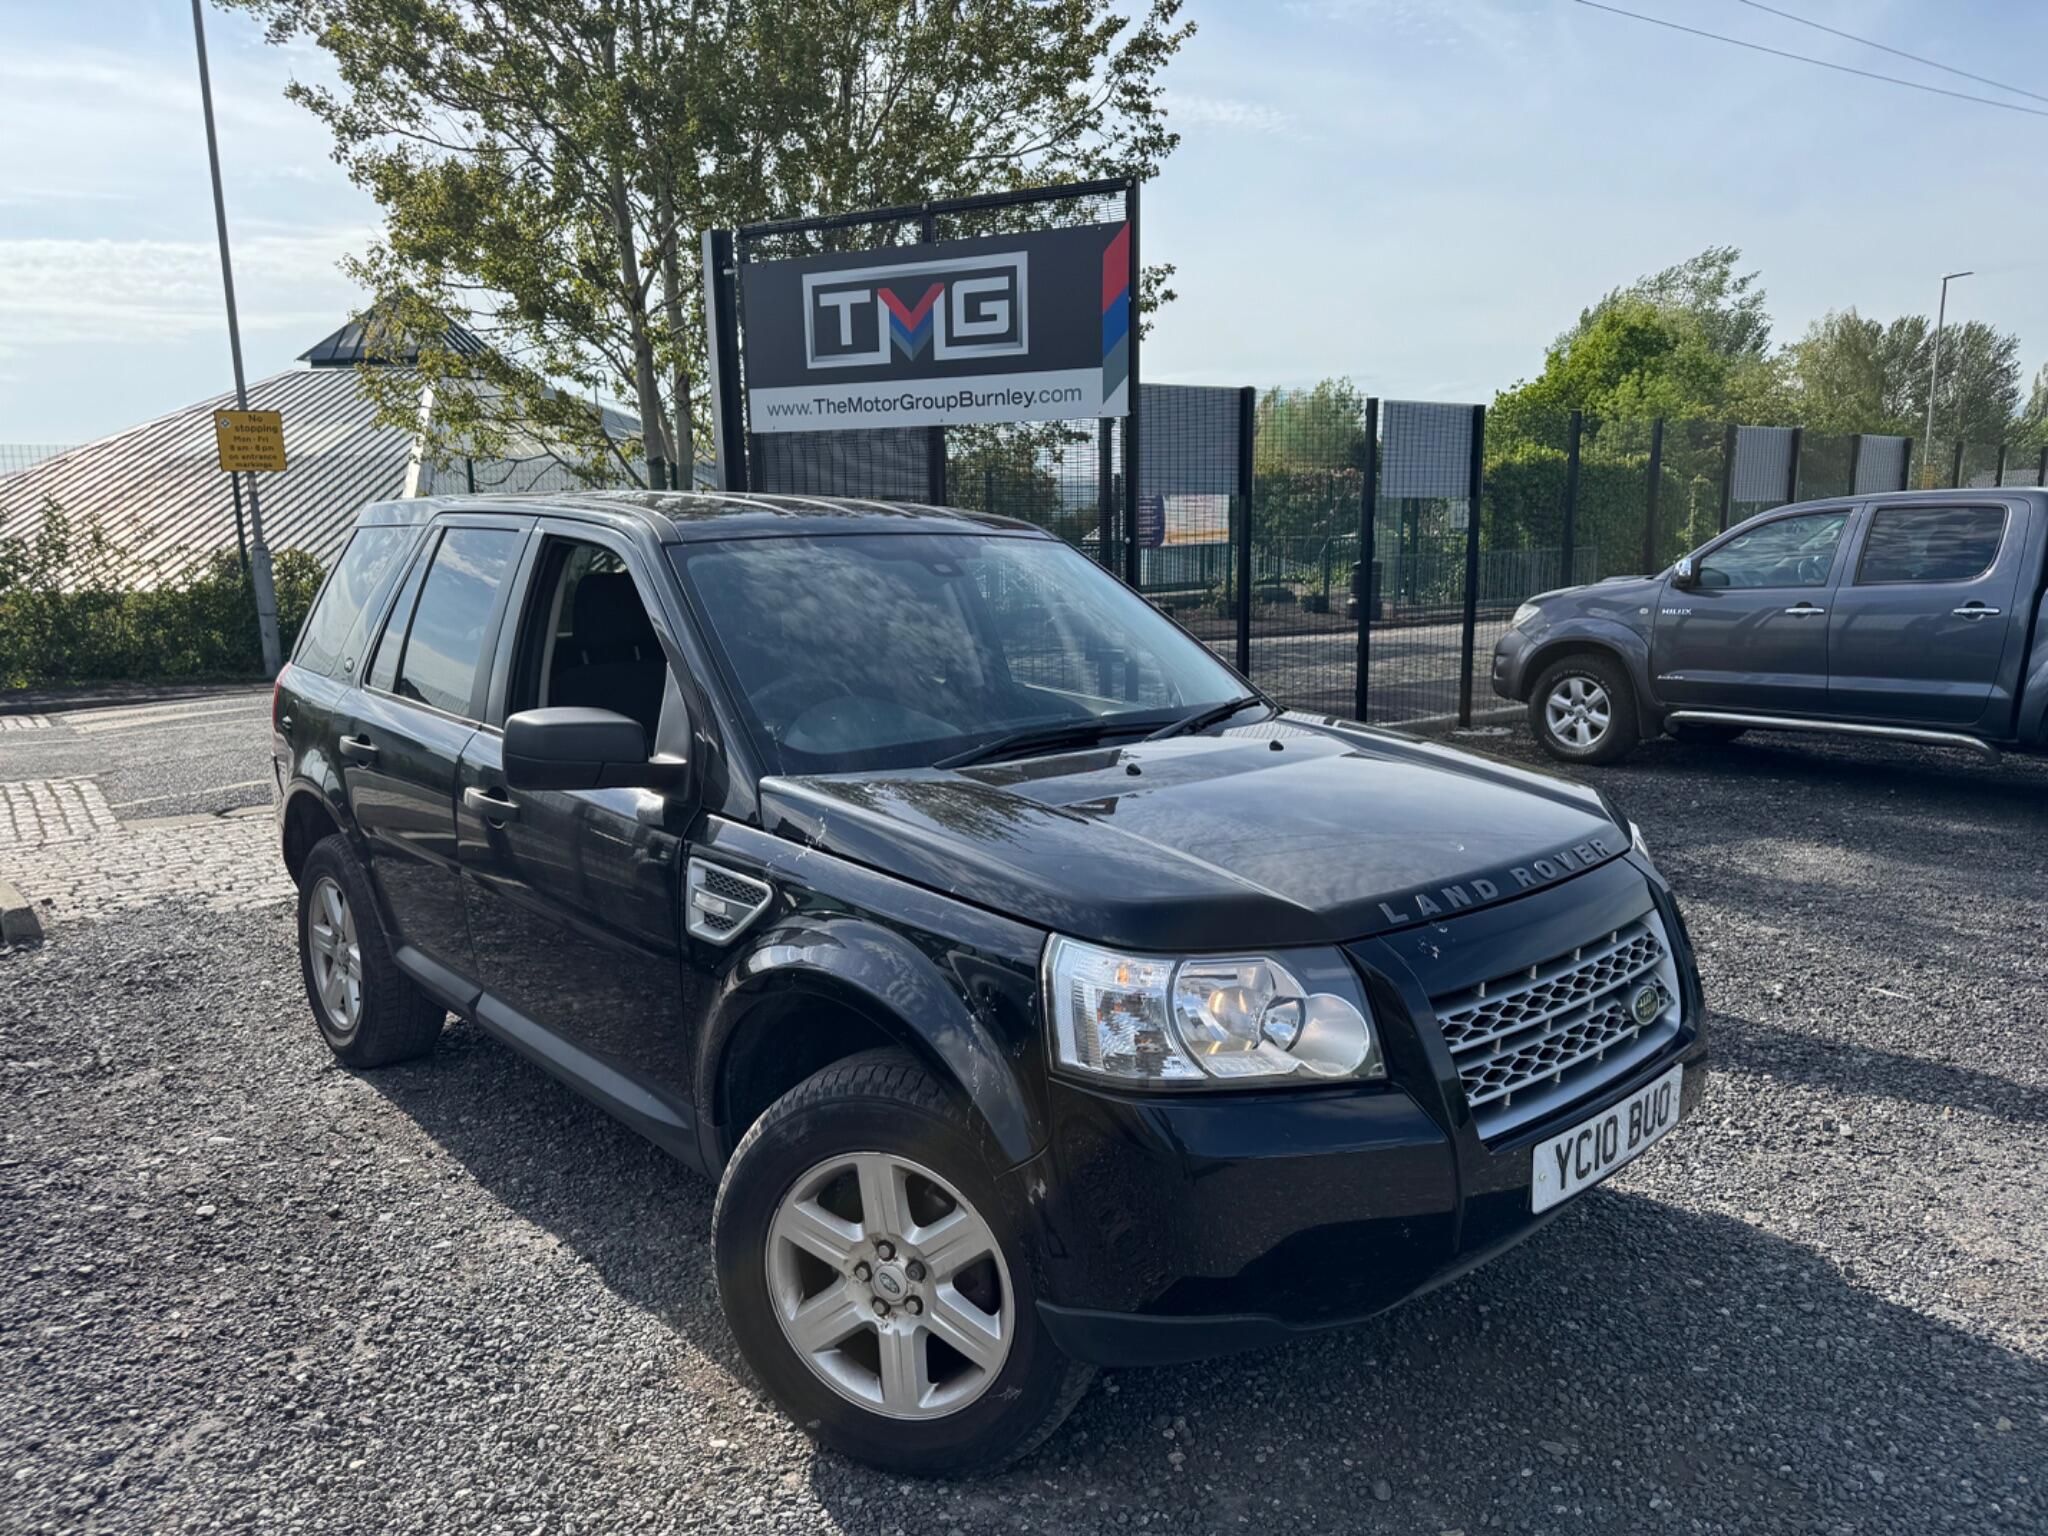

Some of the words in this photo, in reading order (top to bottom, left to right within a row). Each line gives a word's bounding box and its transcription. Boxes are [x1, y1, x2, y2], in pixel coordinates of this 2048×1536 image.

[819, 275, 1011, 363] TMG
[234, 424, 278, 434] stopping
[248, 414, 263, 423] No
[766, 385, 1083, 417] www.TheMotorGroupBurnley.com
[1379, 879, 1499, 925] LAND
[1510, 838, 1610, 888] ROVER
[1555, 1115, 1618, 1190] YC10
[1628, 1080, 1671, 1150] BUO
